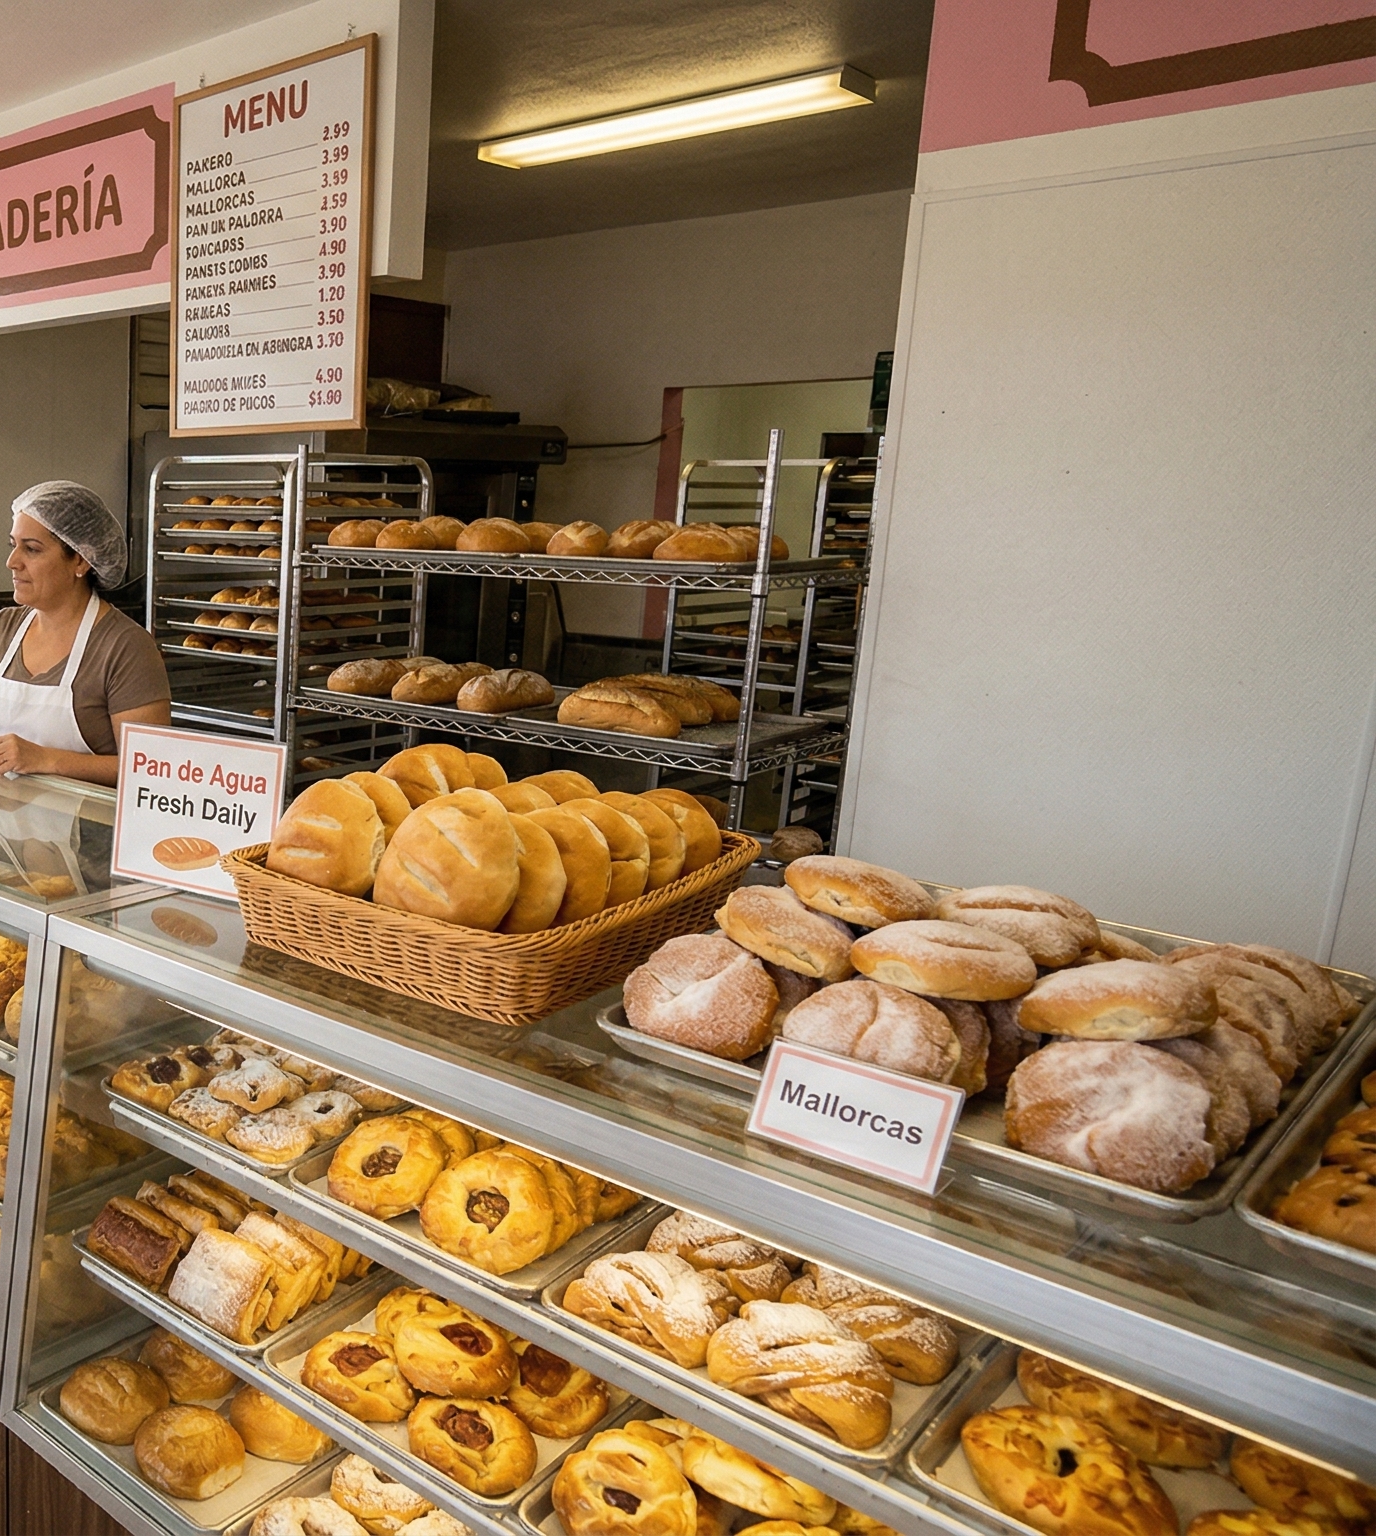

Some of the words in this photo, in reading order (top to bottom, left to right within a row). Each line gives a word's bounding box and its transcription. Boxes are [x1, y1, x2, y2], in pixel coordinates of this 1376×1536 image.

[224, 80, 308, 138] MENU
[186, 171, 246, 197] MALLORCA
[186, 191, 255, 218] MALLORCAS
[186, 222, 208, 238] PAN
[319, 215, 347, 234] 3.90
[319, 238, 346, 257] 4.90
[318, 262, 345, 280] 3.90
[318, 285, 345, 302] 1.20
[317, 308, 344, 326] 3.50
[315, 367, 343, 384] 4.90
[133, 752, 171, 778] Pan
[178, 760, 204, 783] de
[209, 764, 267, 795] Agua
[137, 787, 194, 817] Fresh
[202, 798, 257, 833] Daily
[780, 1079, 923, 1145] Mallorcas
